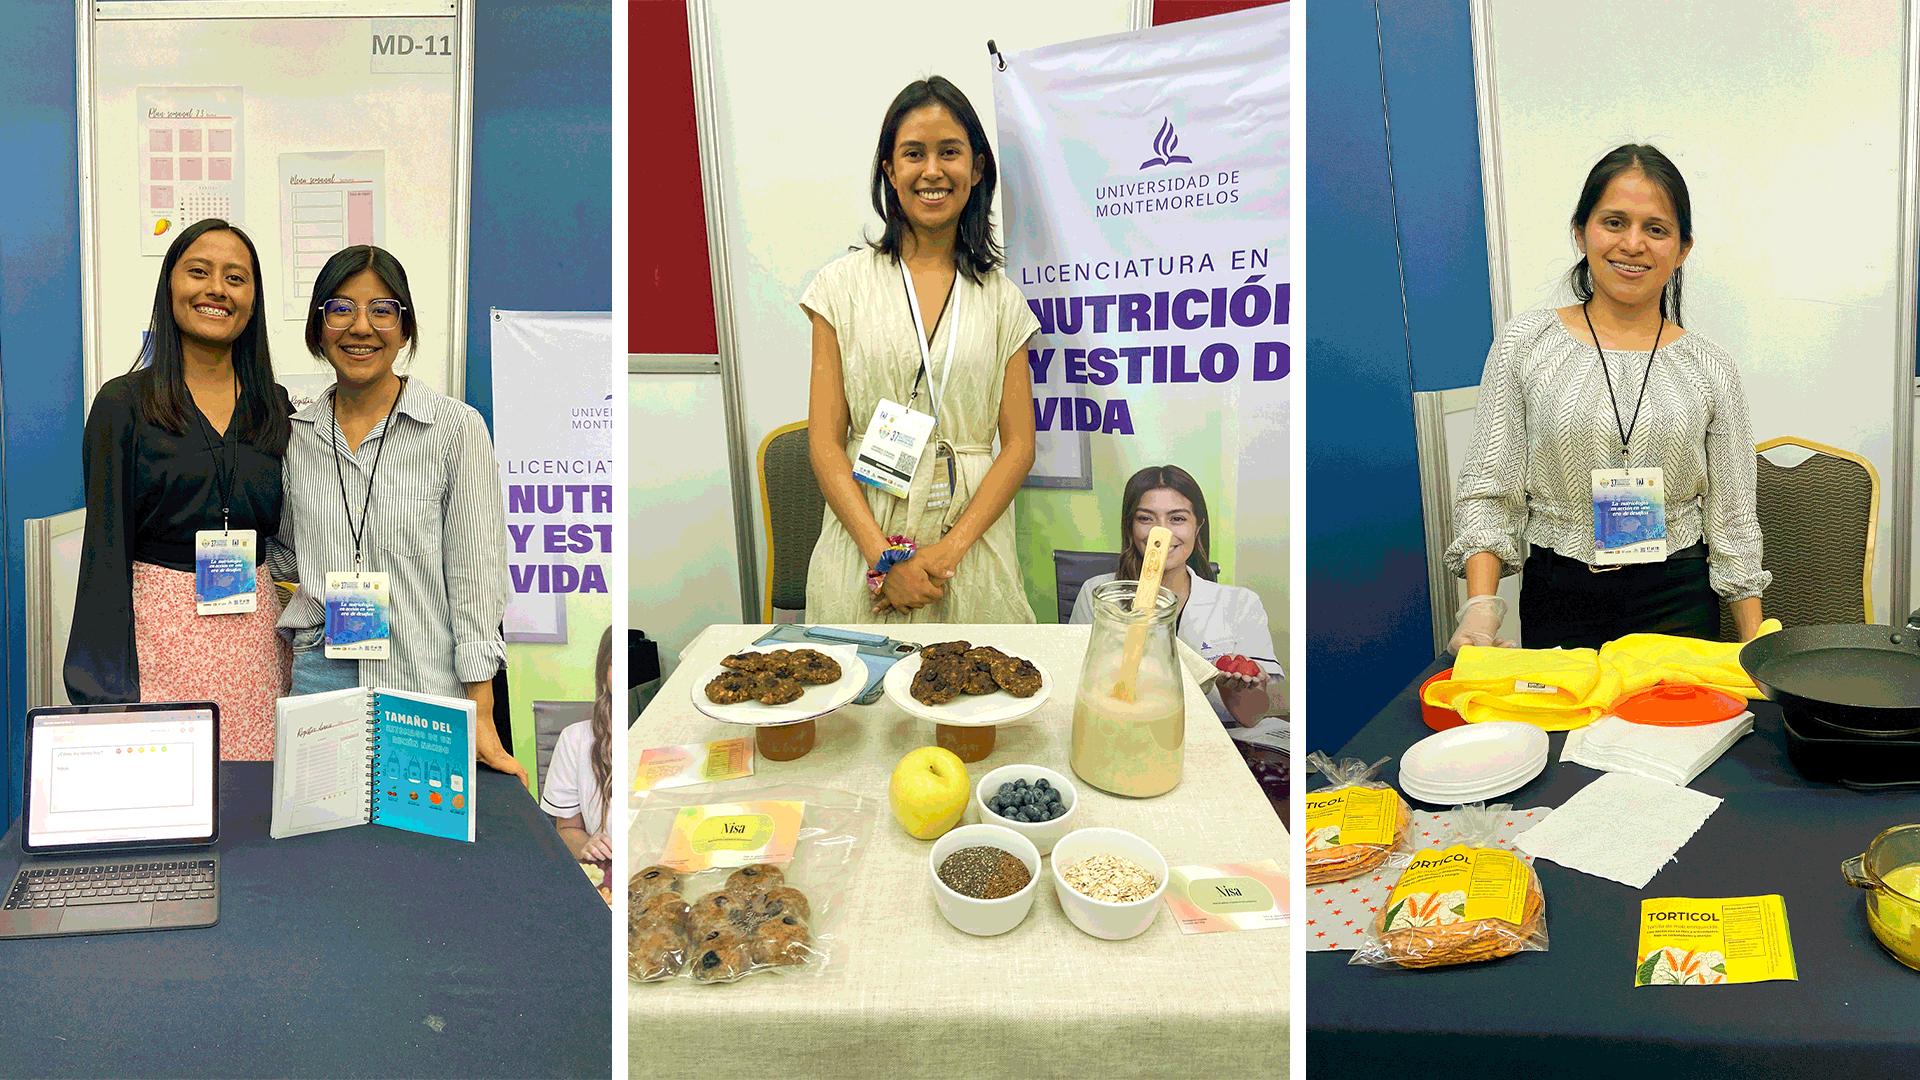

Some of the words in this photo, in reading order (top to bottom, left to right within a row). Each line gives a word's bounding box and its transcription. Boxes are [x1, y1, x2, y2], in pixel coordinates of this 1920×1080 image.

[372, 35, 452, 56] MD-11
[1096, 174, 1210, 200] UNIVERSIDAD
[1218, 170, 1240, 184] DE
[1096, 189, 1239, 218] MONTEMORELOS
[1022, 253, 1215, 285] LICENCIATURA
[1231, 248, 1269, 271] EN
[1027, 348, 1056, 384] Y
[1064, 342, 1240, 386] ESTILO
[571, 407, 612, 418] UNIVE
[571, 420, 612, 430] MONT
[1033, 397, 1135, 435] VIDA
[508, 484, 612, 514] NUTR
[507, 524, 535, 553] Y
[543, 523, 612, 554] EST
[508, 564, 608, 594] VIDA
[384, 710, 428, 728] TAMAÑO
[432, 720, 452, 733] DEL
[1306, 797, 1344, 809] TICOL
[721, 822, 746, 834] Nisa
[1215, 885, 1242, 897] Nisa
[1647, 911, 1720, 922] TORTICOL
